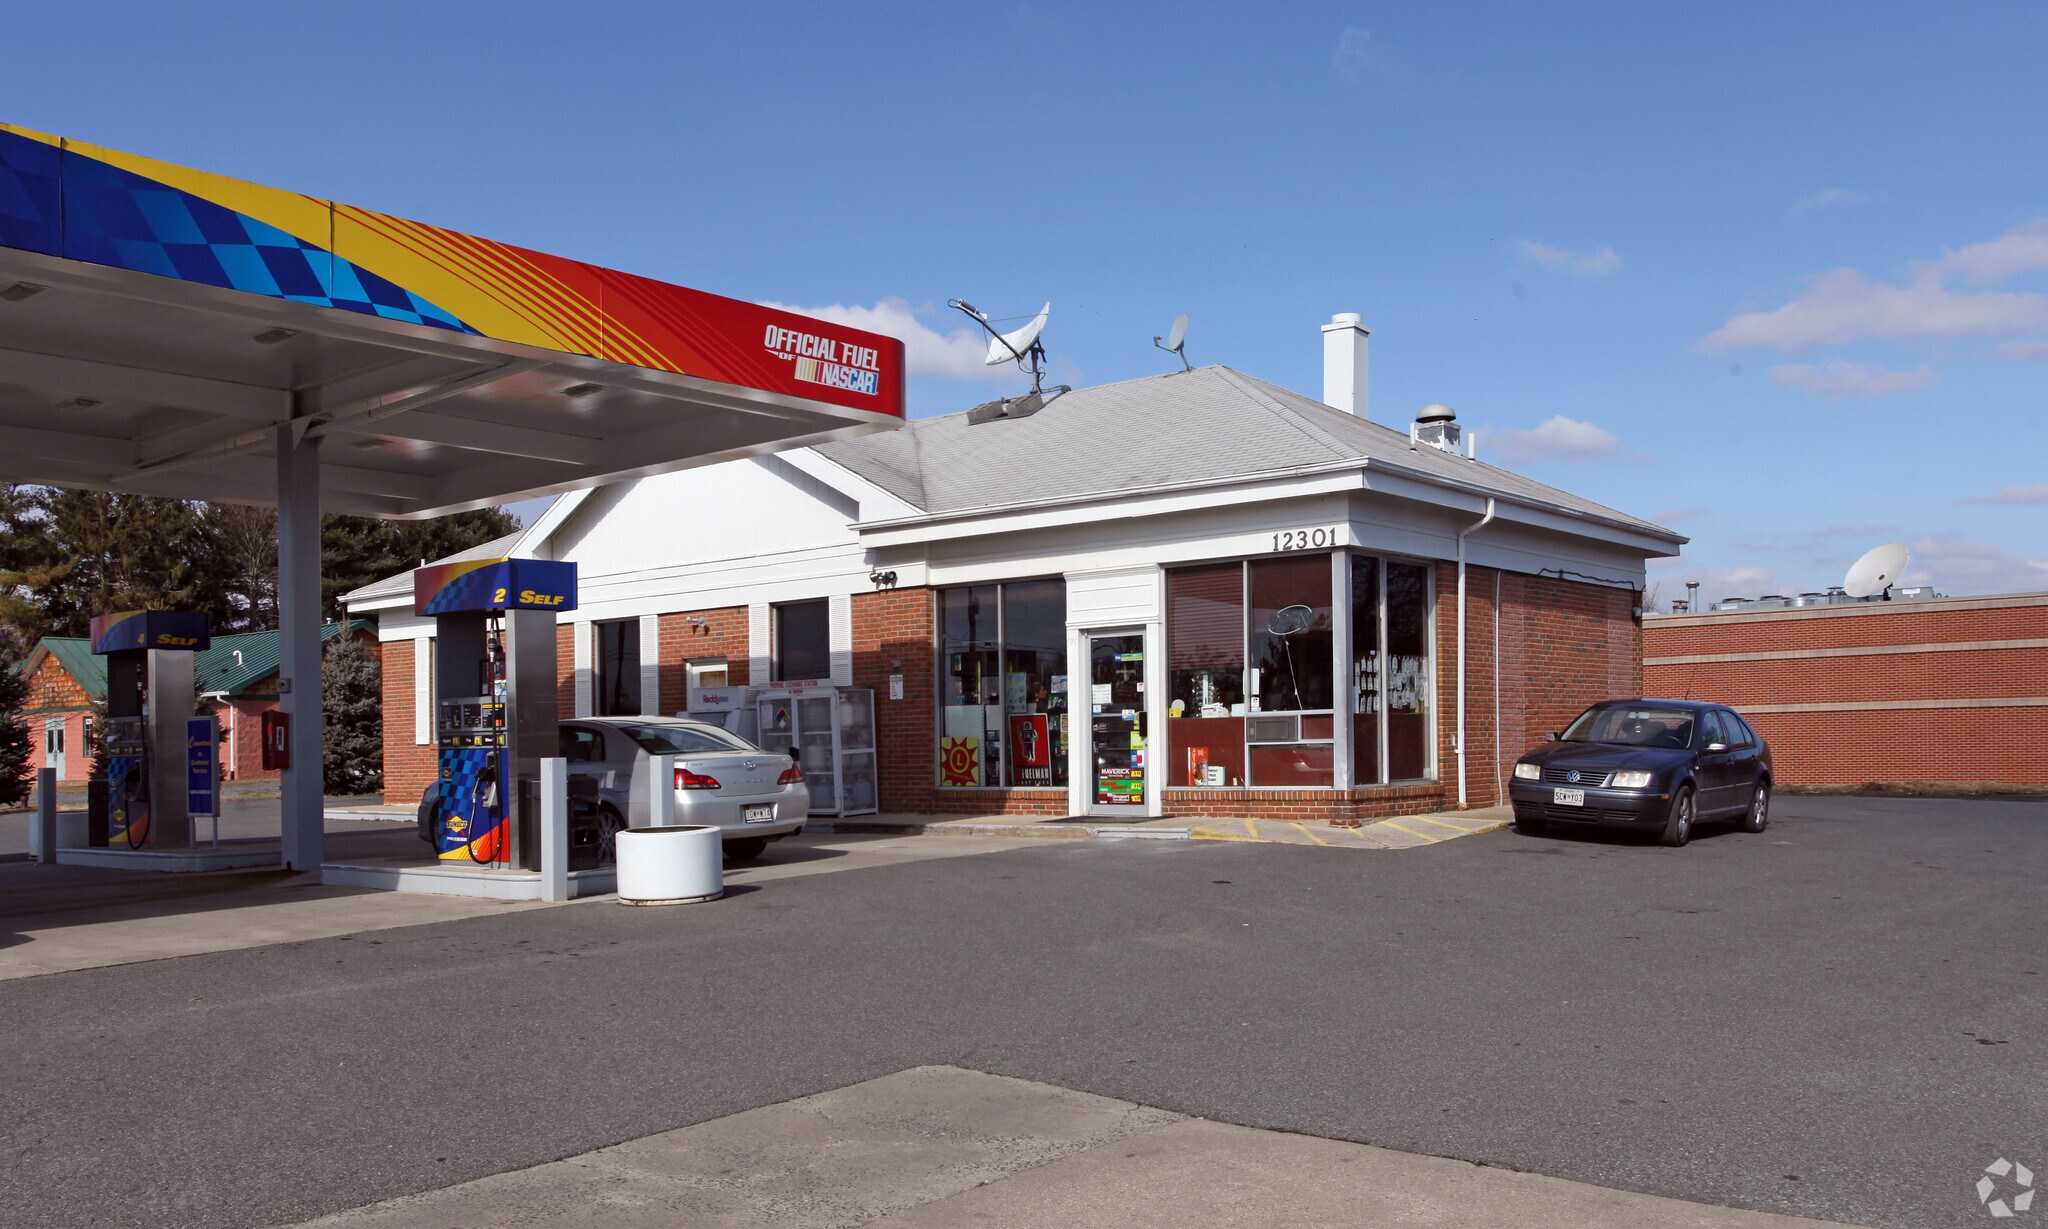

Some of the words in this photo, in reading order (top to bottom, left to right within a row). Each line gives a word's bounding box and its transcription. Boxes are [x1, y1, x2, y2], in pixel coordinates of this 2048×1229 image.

[764, 324, 838, 362] OFFICIAL
[840, 342, 880, 371] FUEL
[778, 351, 797, 361] OF
[821, 362, 876, 394] NASCAR
[1273, 527, 1336, 551] 12301
[494, 588, 506, 603] 2
[519, 590, 564, 605] SELF
[138, 633, 145, 644] 4
[158, 634, 198, 646] SELF
[446, 820, 468, 829] SUNOCO
